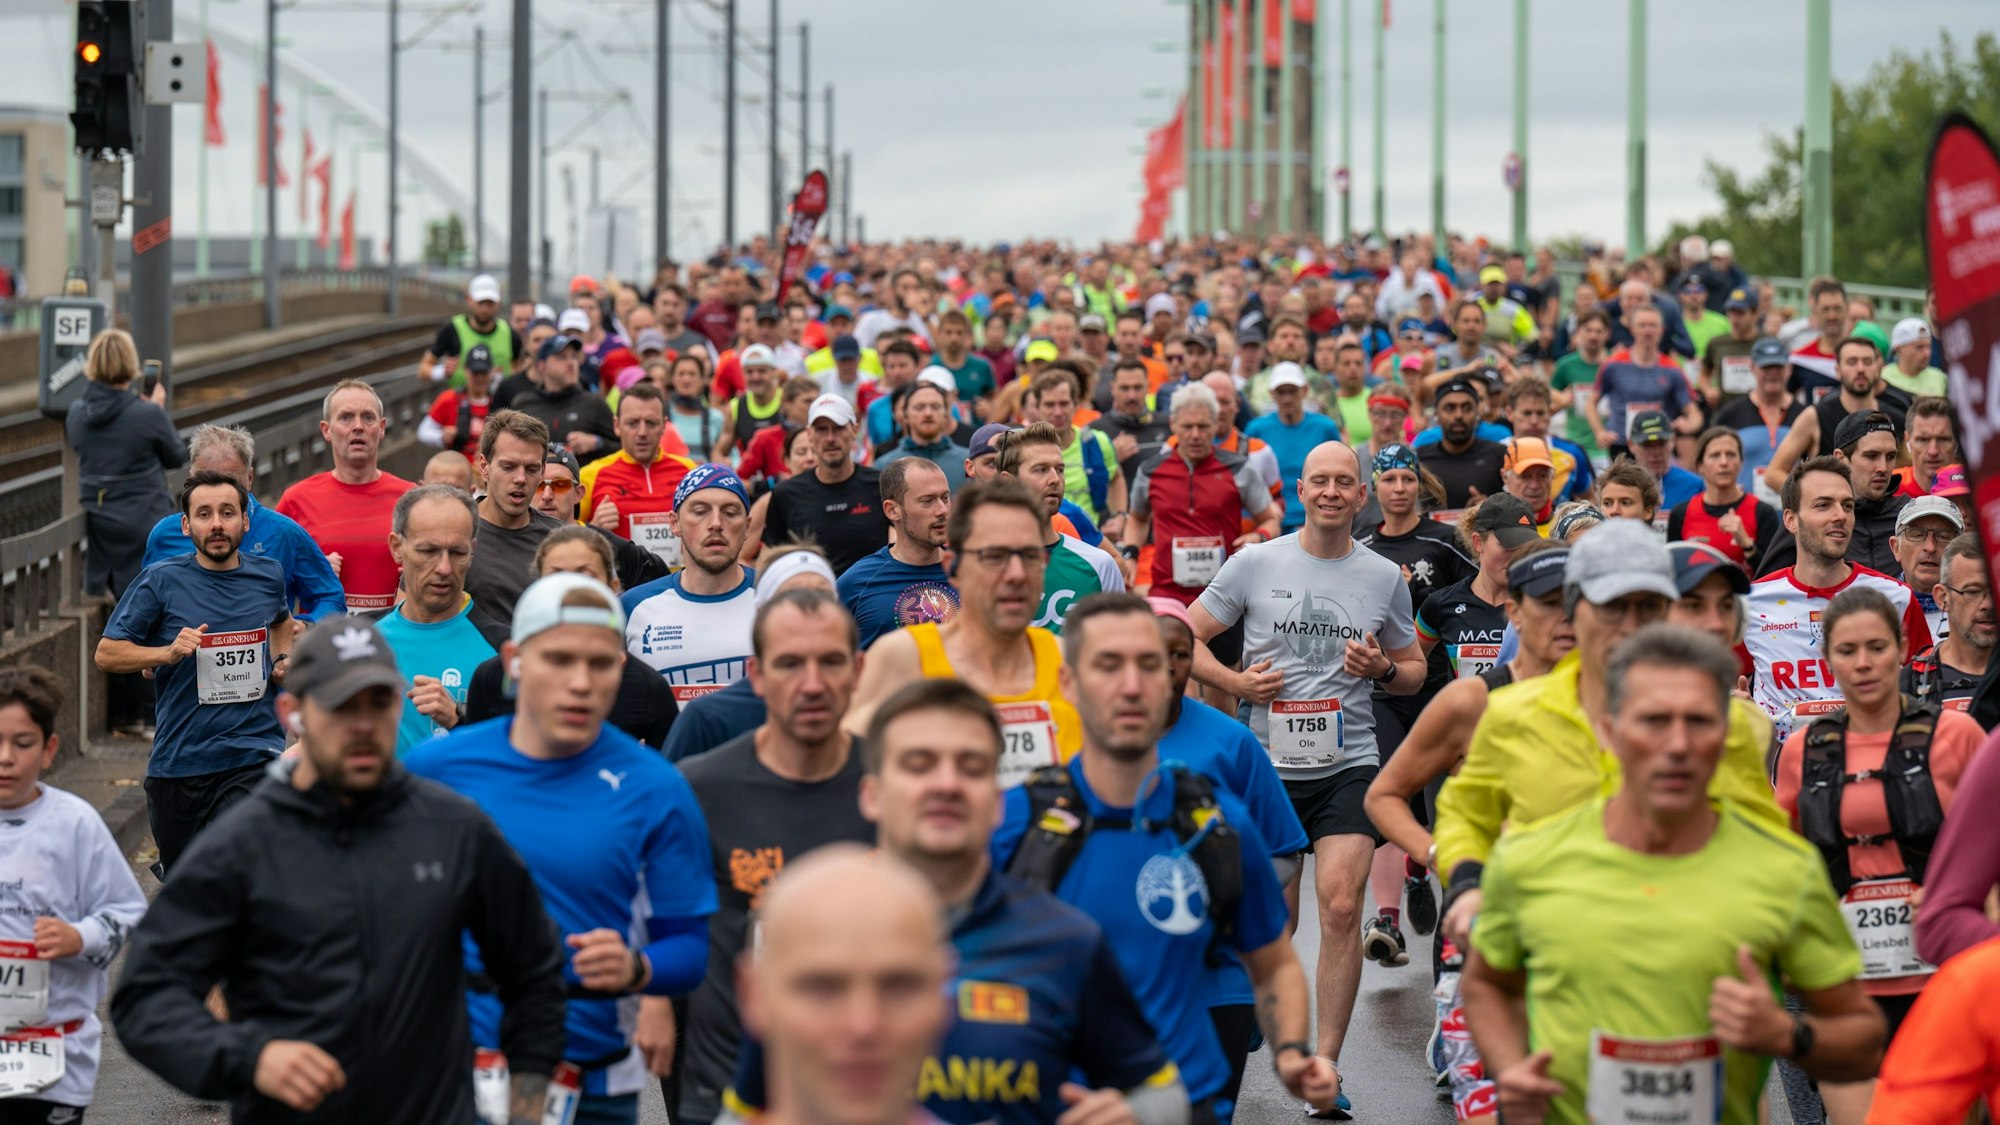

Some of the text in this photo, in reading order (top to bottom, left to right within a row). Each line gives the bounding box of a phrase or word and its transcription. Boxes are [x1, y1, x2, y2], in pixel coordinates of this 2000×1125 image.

[58, 317, 89, 336] SF
[1273, 621, 1363, 641] MARATHON
[1761, 621, 1799, 632] uhlsport
[223, 632, 259, 644] GENERALI
[1458, 629, 1504, 642] MAC
[215, 649, 255, 667] 3573
[1306, 665, 1324, 674] 2022
[223, 672, 251, 682] Kamil
[1293, 701, 1331, 712] GENERALI
[1821, 703, 1847, 713] GEN
[1286, 717, 1327, 733] 1758
[1299, 739, 1315, 748] Ole
[1856, 905, 1911, 928] 2362
[1862, 936, 1910, 950] Liesbet
